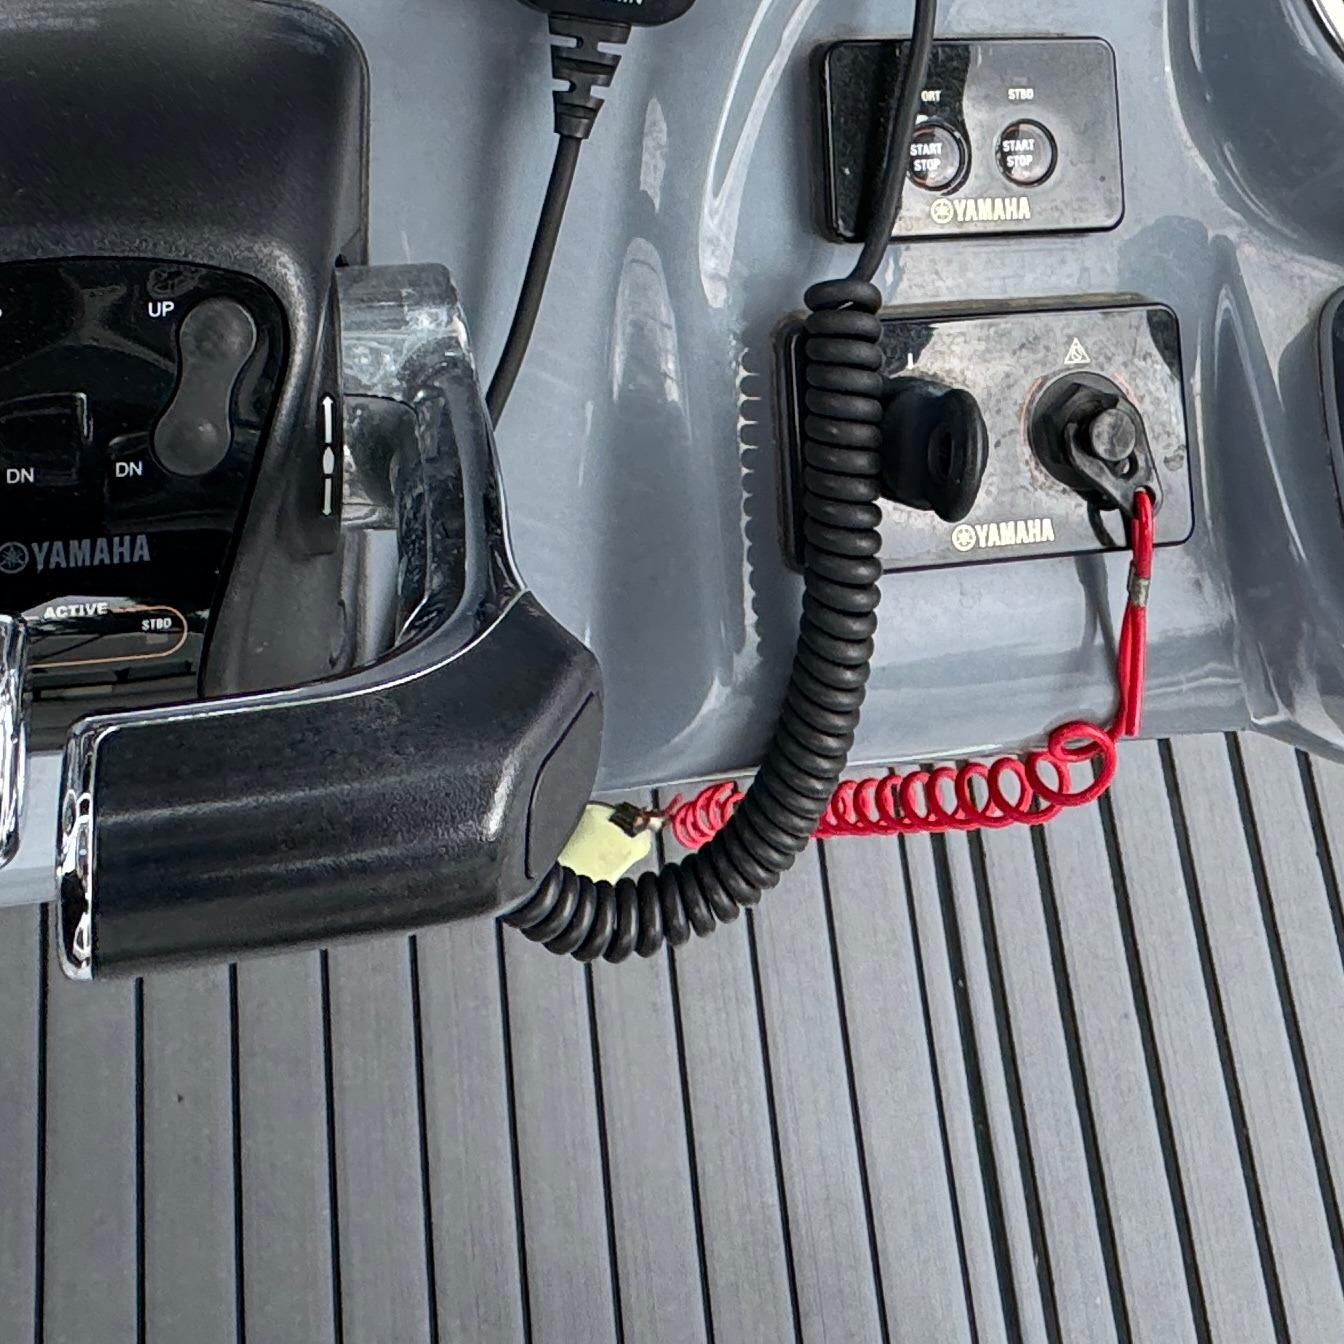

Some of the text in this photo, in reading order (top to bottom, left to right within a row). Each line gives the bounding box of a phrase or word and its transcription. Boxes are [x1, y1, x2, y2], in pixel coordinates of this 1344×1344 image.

[1007, 87, 1035, 101] STBD
[909, 141, 944, 157] START
[1001, 138, 1036, 153] START
[913, 158, 942, 172] STOP
[1005, 154, 1034, 169] STOP
[953, 196, 1032, 222] YAMAHA
[147, 299, 176, 319] UP
[5, 466, 36, 486] DN
[114, 460, 144, 479] DN
[975, 517, 1056, 549] YAMAHA
[30, 532, 152, 574] YAMAHA
[42, 602, 109, 619] ACTIVE
[141, 617, 173, 632] STBD
